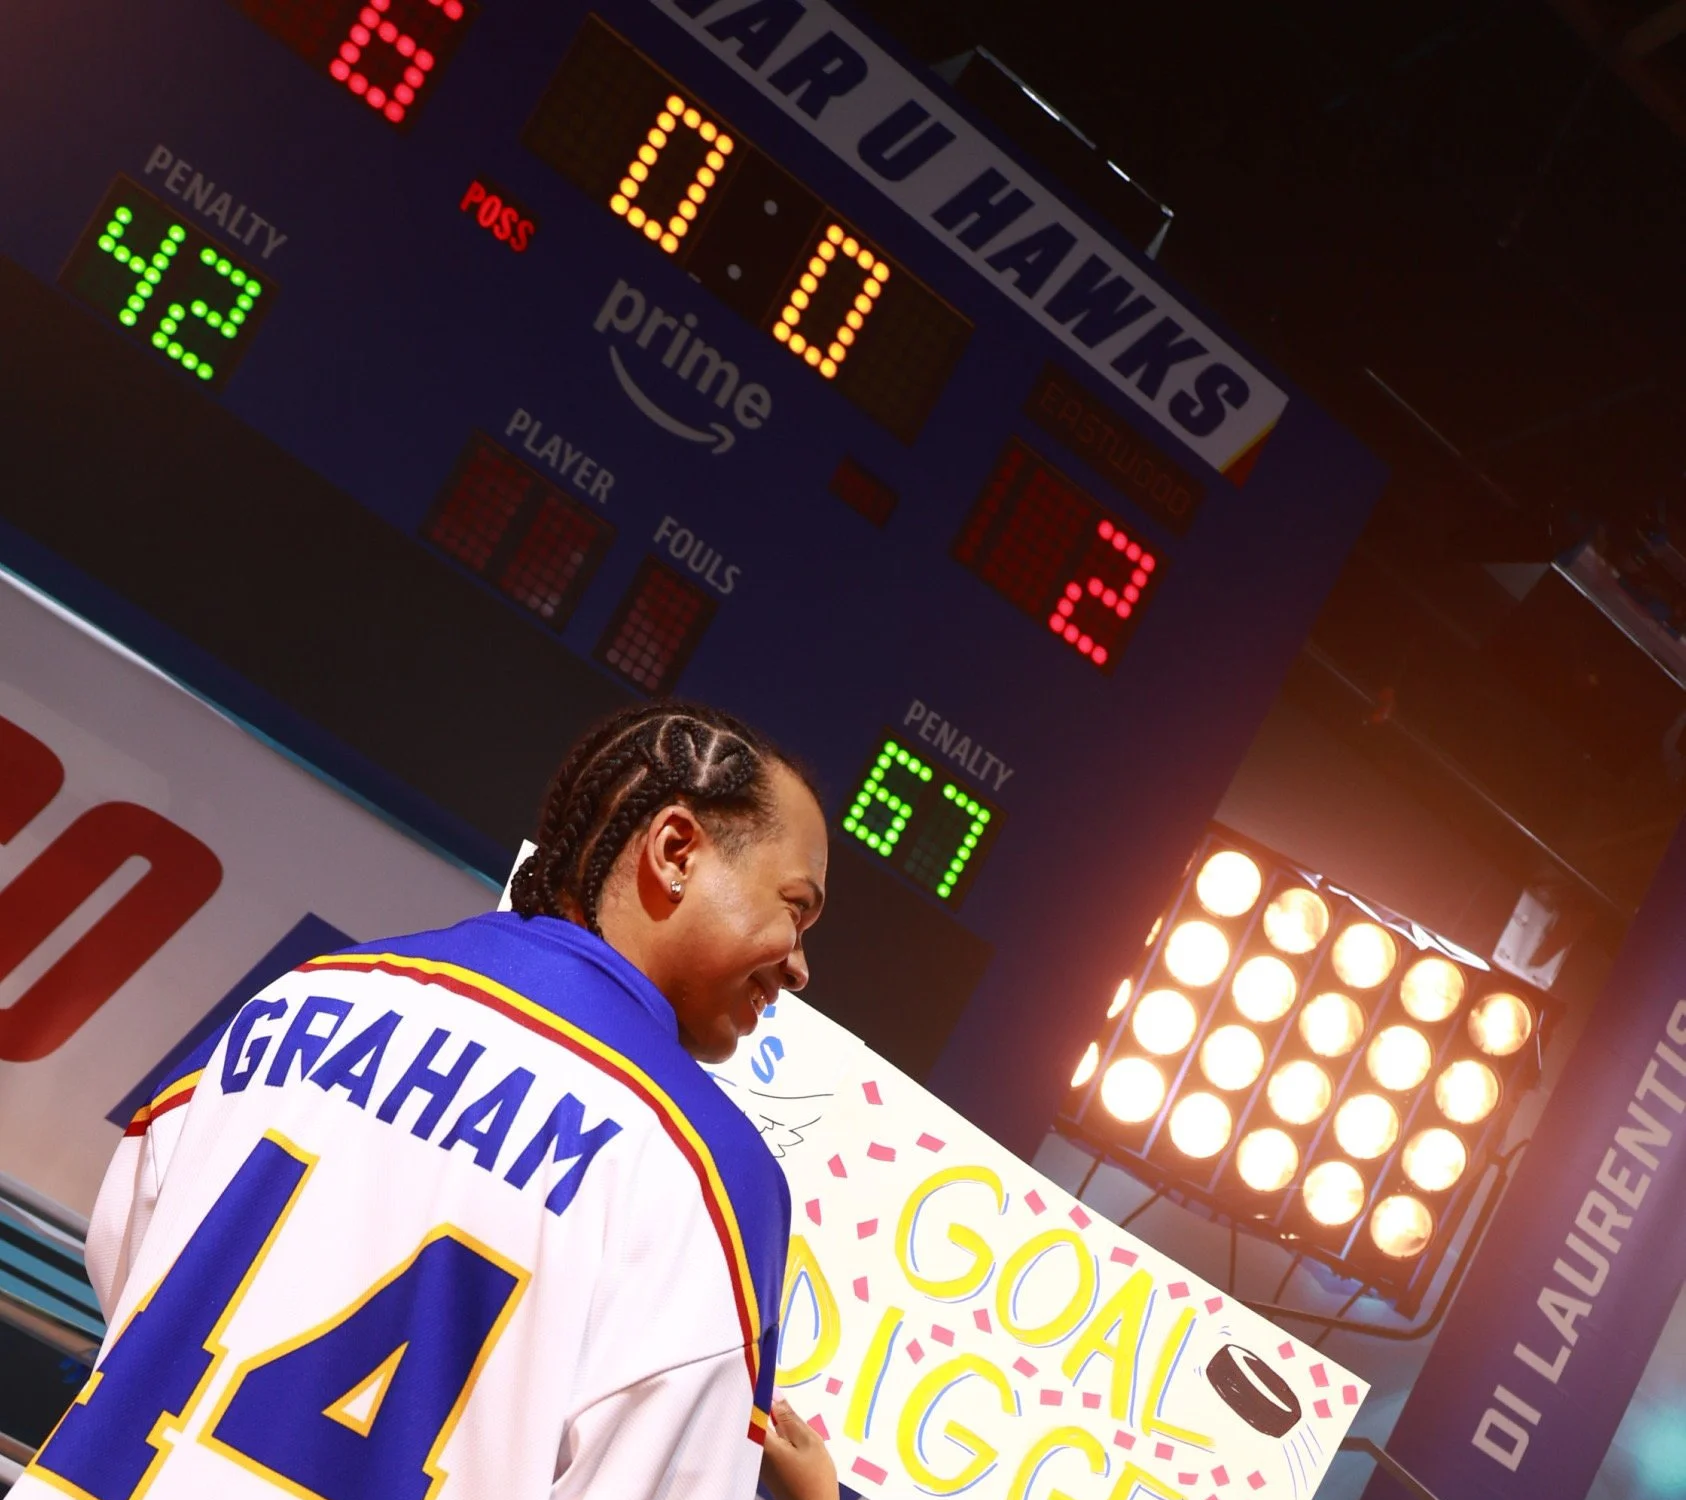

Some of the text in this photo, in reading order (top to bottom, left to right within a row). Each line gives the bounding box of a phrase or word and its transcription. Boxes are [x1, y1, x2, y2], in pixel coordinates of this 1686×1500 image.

[328, 0, 465, 123] 6
[144, 145, 288, 261] PENALTY
[459, 180, 536, 254] POSS
[674, 0, 1251, 438] AR U HAWKS
[98, 206, 262, 381] 42
[594, 278, 773, 431] prime
[505, 408, 616, 504] PLAYER
[653, 516, 742, 596] FOULS
[1047, 518, 1157, 666] 2
[903, 699, 1014, 791] PENALTY
[842, 740, 992, 899] 67
[218, 995, 624, 1216] GRAHAM
[894, 1165, 1215, 1453] GOAL
[1471, 1384, 1542, 1473] DI
